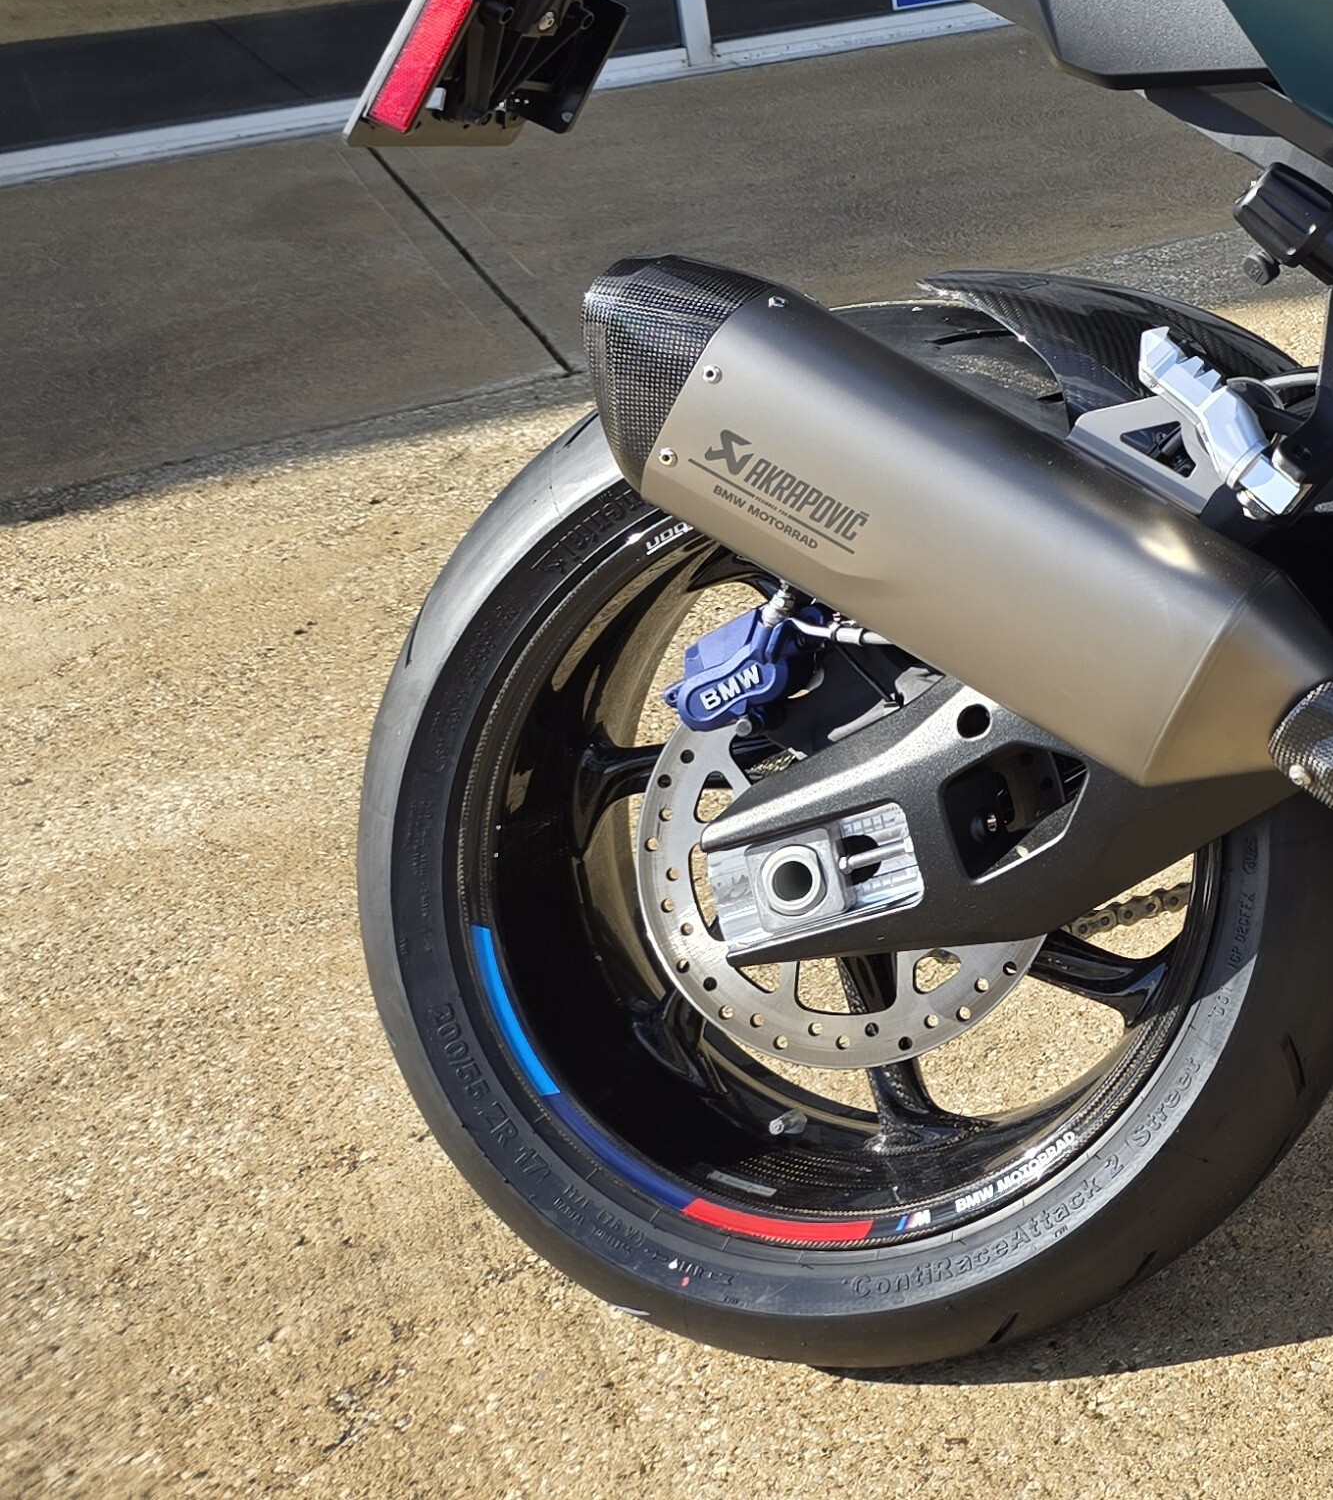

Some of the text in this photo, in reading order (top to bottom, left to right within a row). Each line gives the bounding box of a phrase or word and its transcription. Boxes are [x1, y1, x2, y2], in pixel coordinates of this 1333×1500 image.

[712, 484, 820, 551] BMW MOTORRAD
[743, 457, 871, 542] AKRAPOVIČ
[699, 661, 760, 711] BMW
[850, 1175, 1103, 1299] ContiRaceAttack
[1131, 1056, 1202, 1150] Street
[954, 1186, 997, 1214] BMW
[996, 1131, 1078, 1194] MOTORRAD
